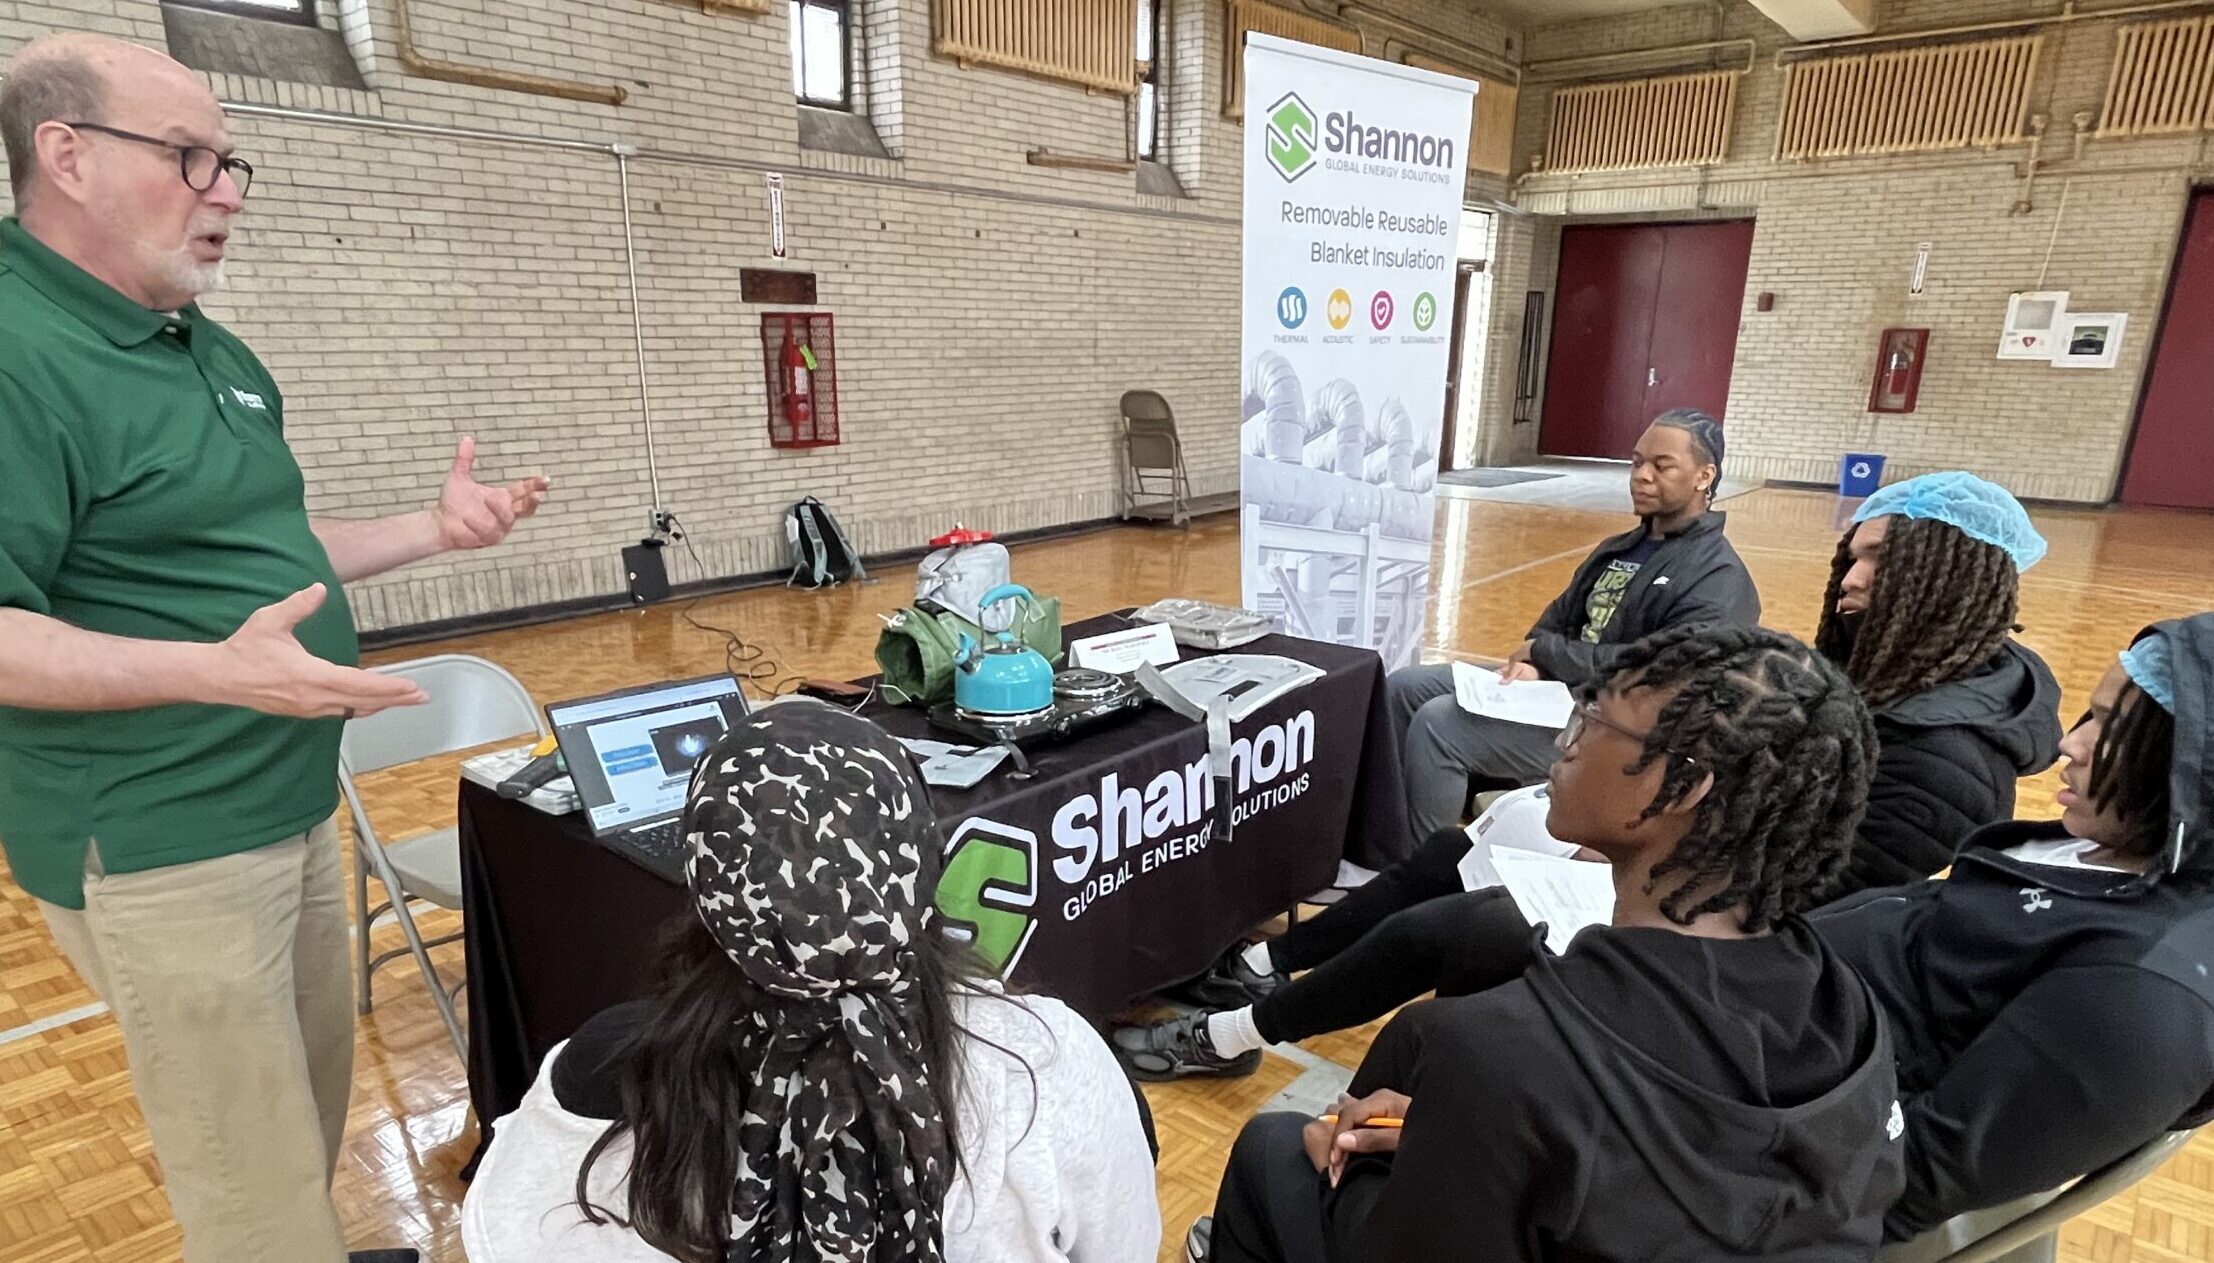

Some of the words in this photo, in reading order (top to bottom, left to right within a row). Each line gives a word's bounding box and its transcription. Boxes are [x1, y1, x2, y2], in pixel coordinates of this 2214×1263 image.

[1325, 111, 1453, 168] Shannon
[1325, 158, 1360, 174] GLOBAL
[1363, 164, 1398, 179] ENERGY
[1401, 169, 1450, 185] SOLUTIONS
[1281, 201, 1374, 229] Removable
[1378, 211, 1447, 236] Reusable
[1310, 240, 1369, 266] Blanket
[1372, 246, 1445, 271] Insulation
[1273, 335, 1309, 344] THERMAL
[1063, 864, 1134, 922] GLOBAL
[1141, 817, 1215, 874] ENERGY
[1232, 772, 1311, 827] OLUTIONS
